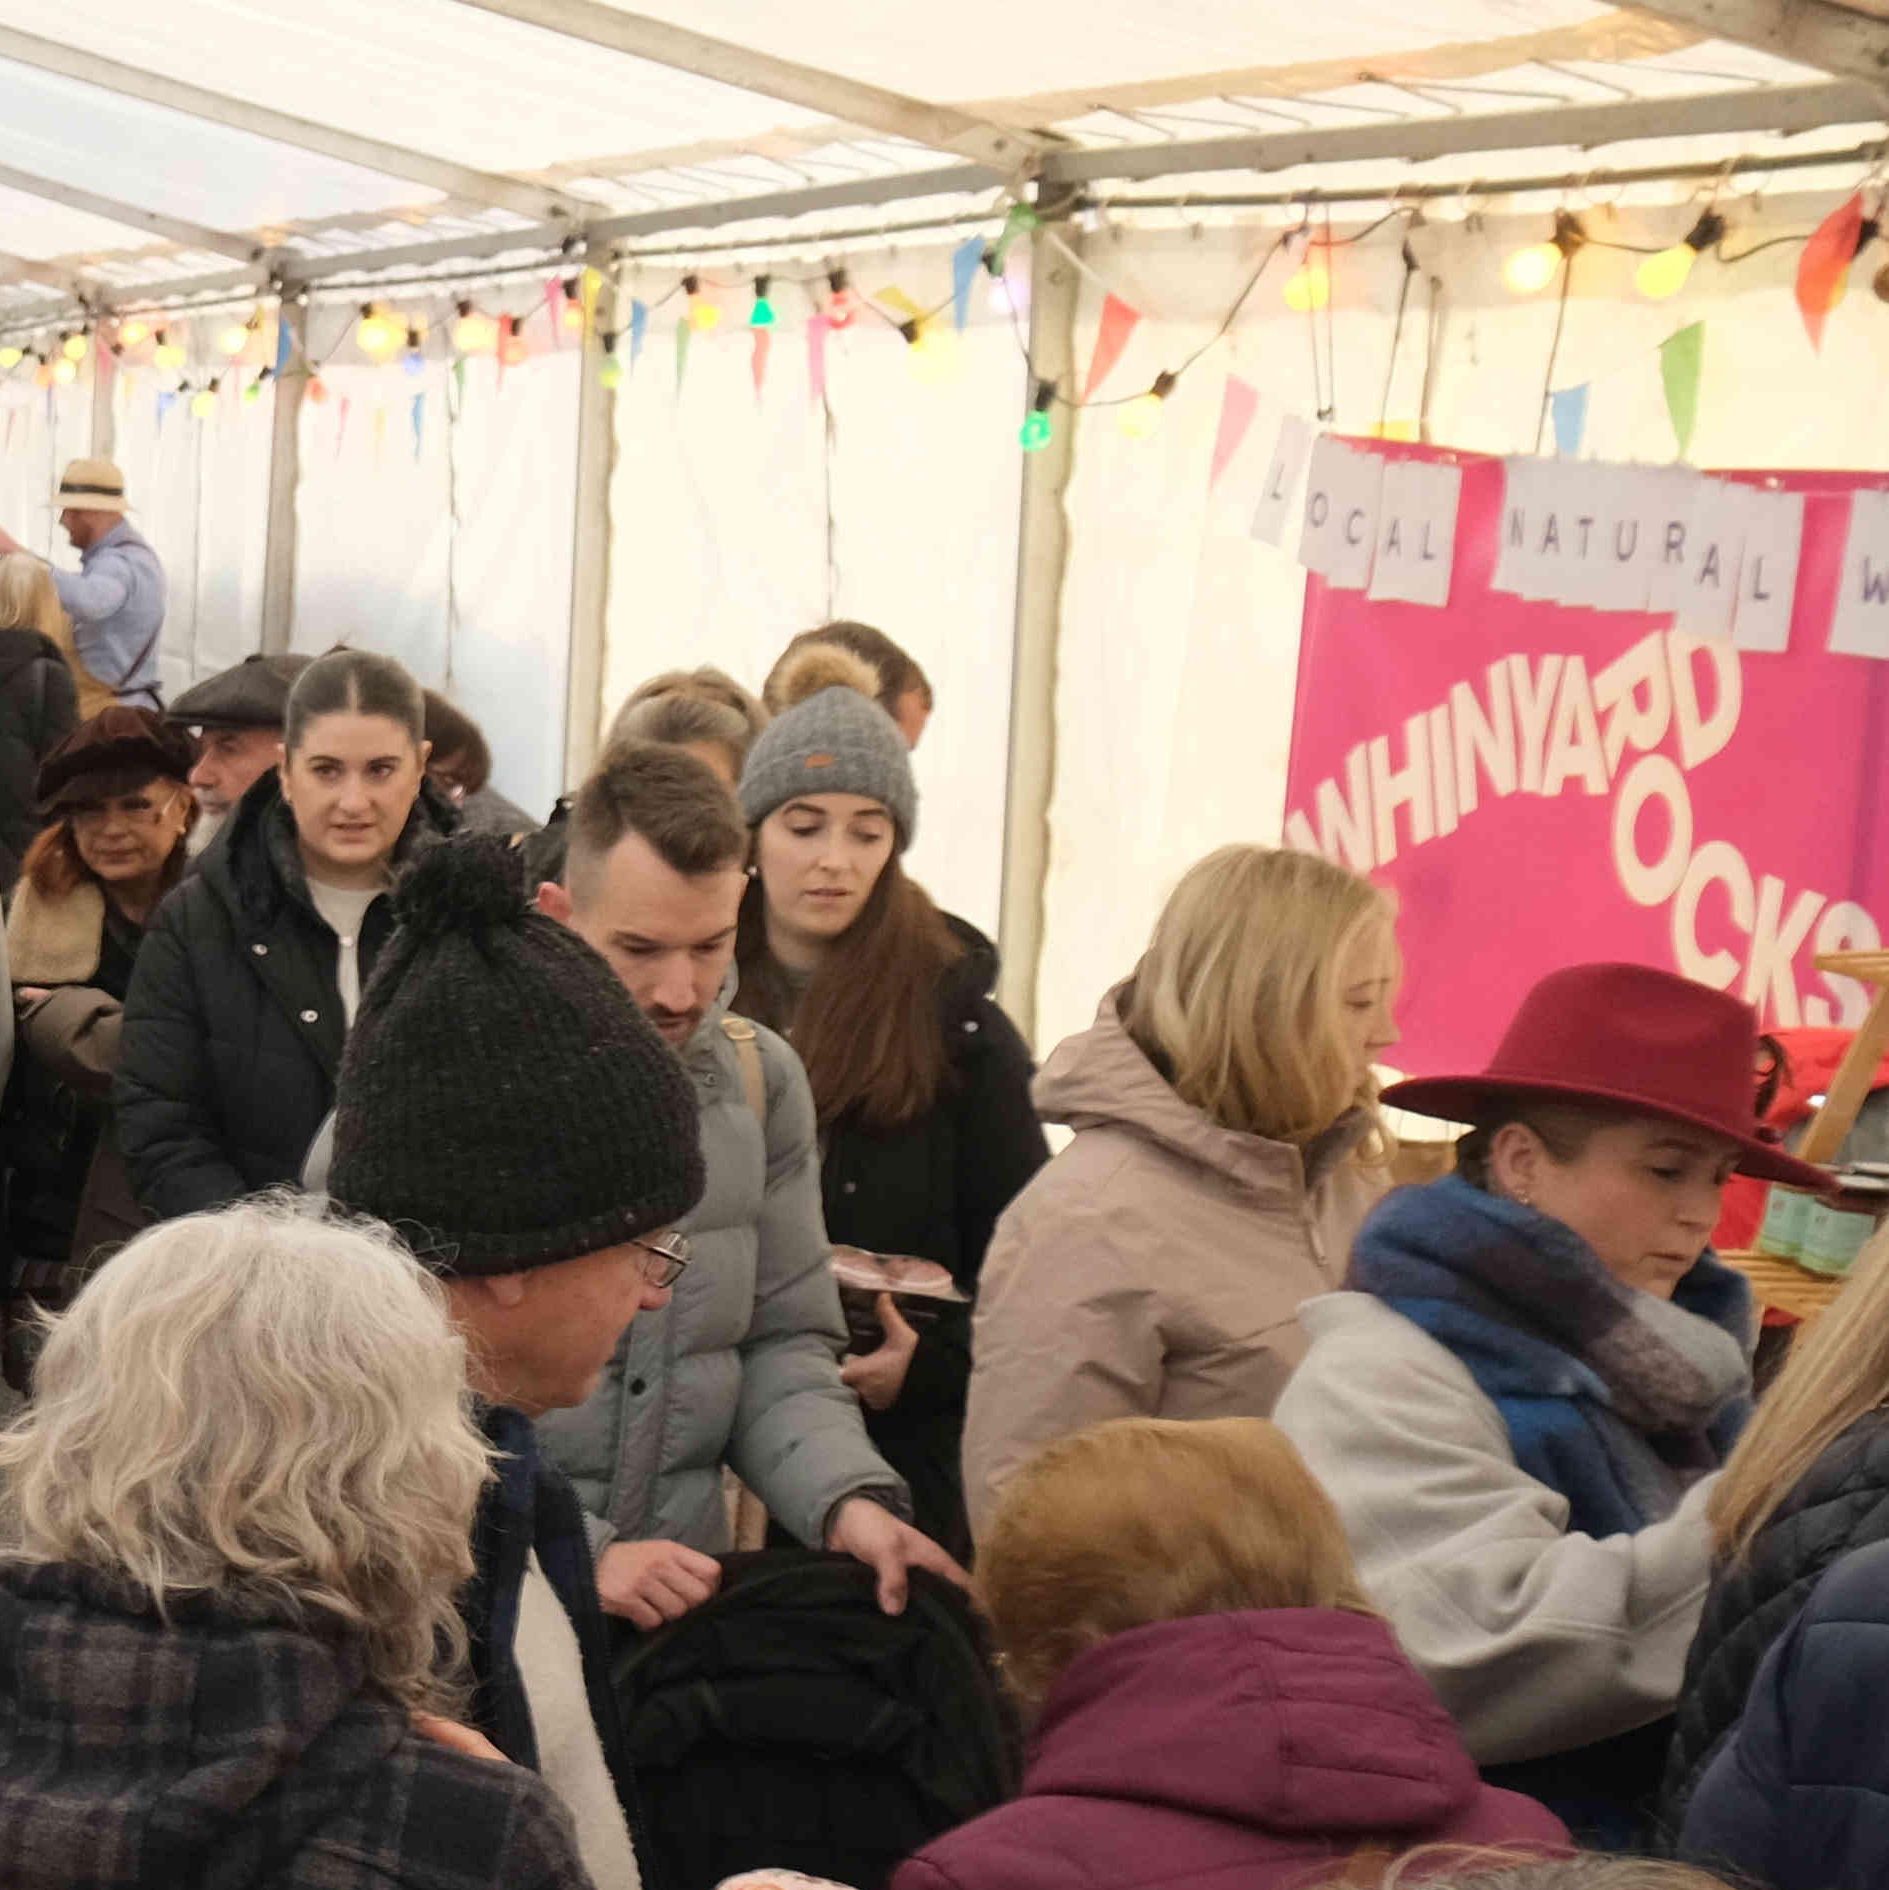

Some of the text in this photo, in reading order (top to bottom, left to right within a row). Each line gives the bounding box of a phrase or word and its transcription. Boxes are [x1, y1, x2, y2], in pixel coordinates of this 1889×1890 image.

[1268, 463, 1436, 561] LOCAL
[1508, 506, 1773, 601] NATURAL
[1285, 628, 1742, 872] WHINYARD
